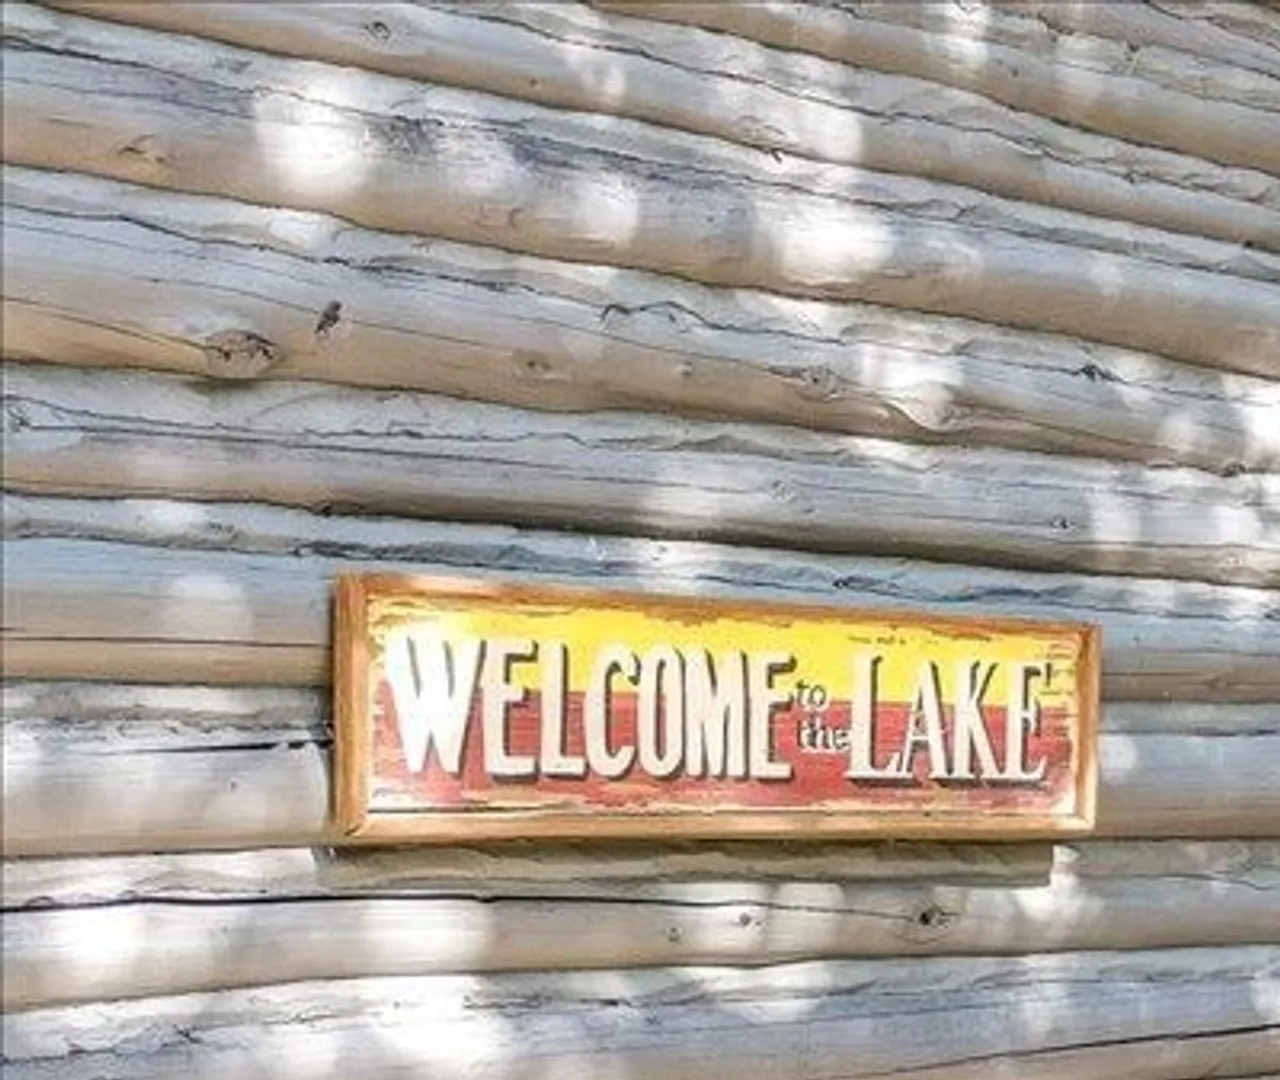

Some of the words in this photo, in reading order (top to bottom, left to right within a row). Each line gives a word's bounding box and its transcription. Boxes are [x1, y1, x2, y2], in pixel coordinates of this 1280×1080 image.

[384, 634, 796, 780] WELCOME
[795, 678, 828, 711] to
[796, 714, 850, 755] the
[843, 650, 1048, 782] LAKE
